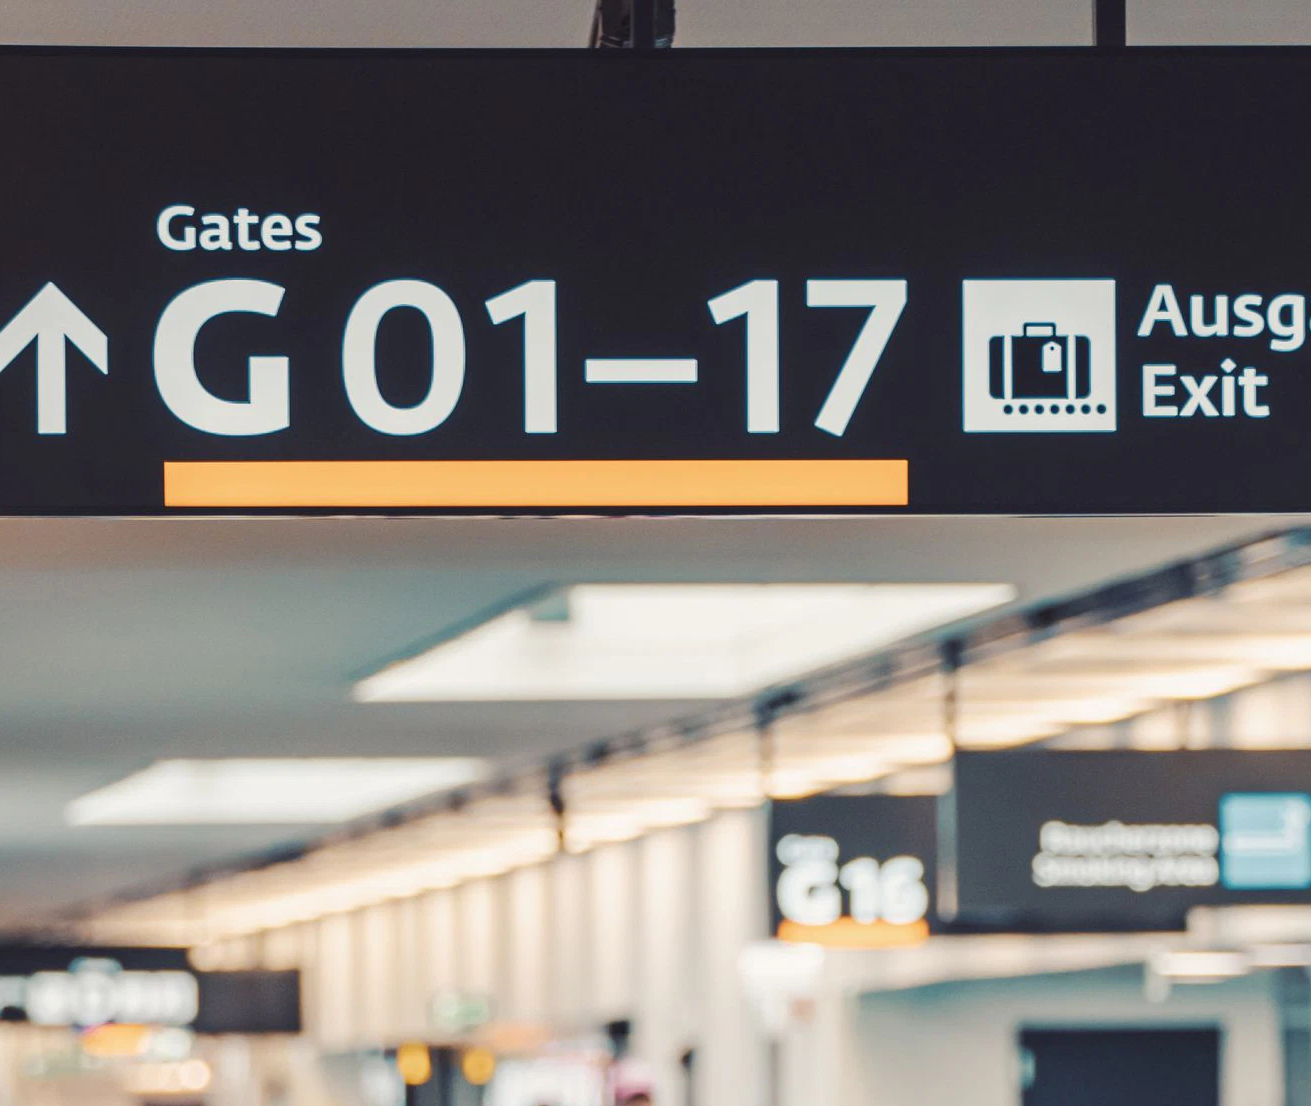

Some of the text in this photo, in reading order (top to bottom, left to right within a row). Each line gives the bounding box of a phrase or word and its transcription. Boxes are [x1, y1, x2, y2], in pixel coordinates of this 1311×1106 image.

[156, 205, 323, 251] Gates
[152, 278, 290, 436] G
[1142, 358, 1270, 418] Exit
